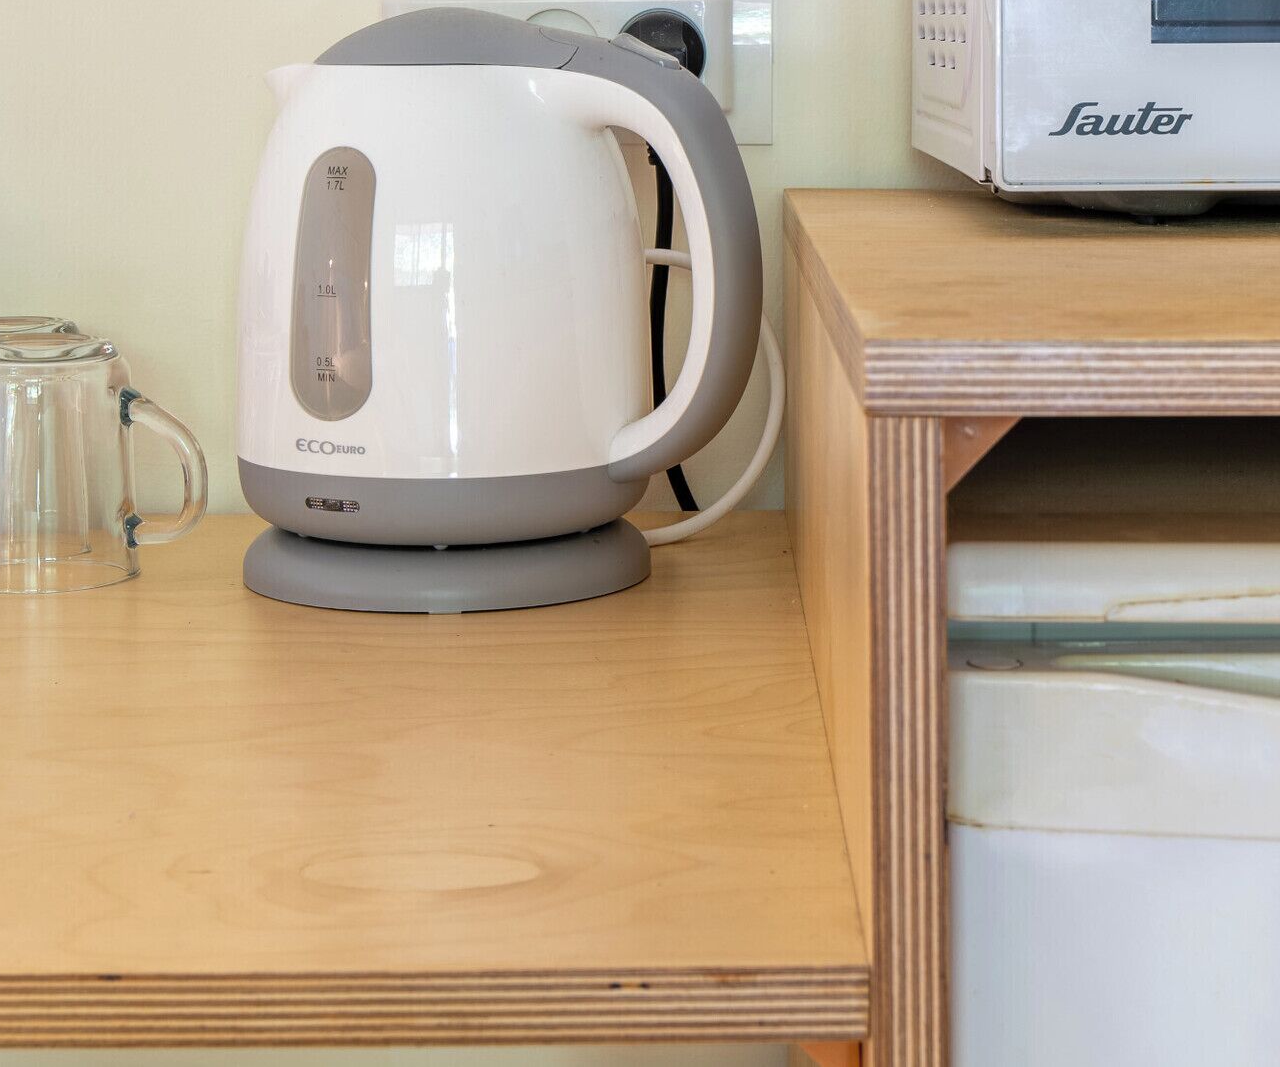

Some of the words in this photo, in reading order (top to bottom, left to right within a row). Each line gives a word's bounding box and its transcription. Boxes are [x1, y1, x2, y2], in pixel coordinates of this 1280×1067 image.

[1048, 101, 1193, 137] Sauter
[327, 166, 348, 175] MAX
[317, 373, 335, 382] MIN
